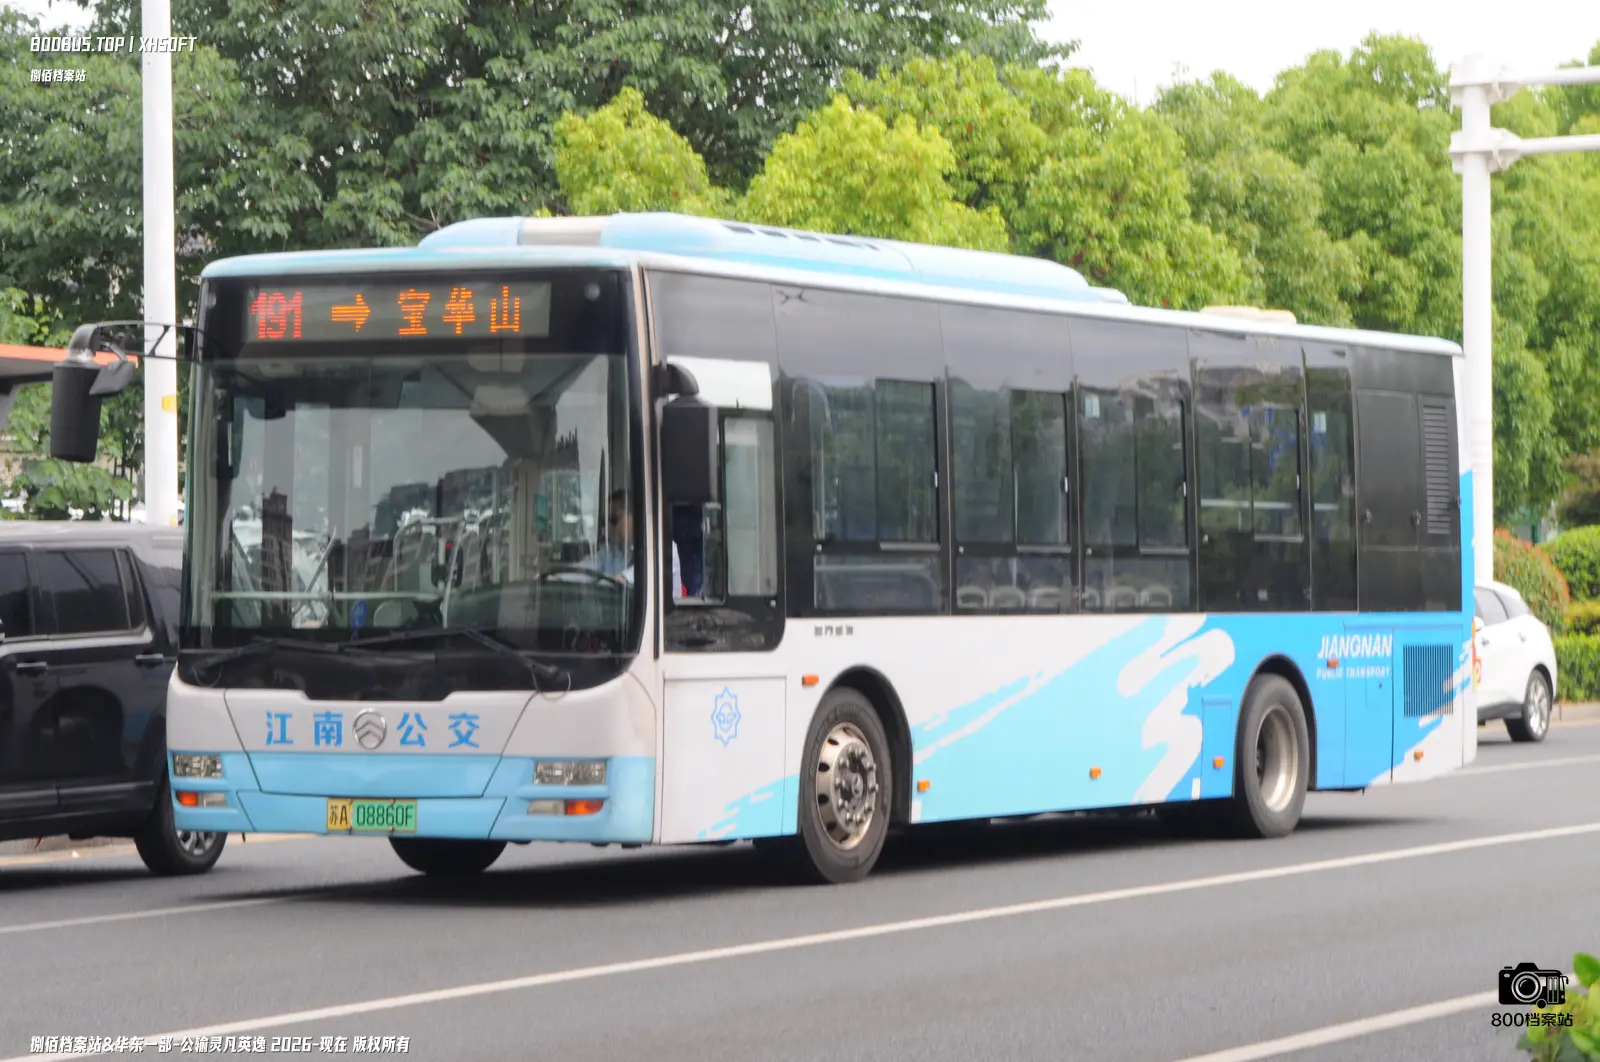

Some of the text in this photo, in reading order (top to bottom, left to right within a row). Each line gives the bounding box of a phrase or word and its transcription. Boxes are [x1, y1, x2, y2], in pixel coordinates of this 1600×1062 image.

[252, 291, 302, 339] 191
[398, 286, 520, 335] 宝华山
[1317, 633, 1393, 659] JIANGNAN
[1346, 665, 1390, 678] TRANSPORT
